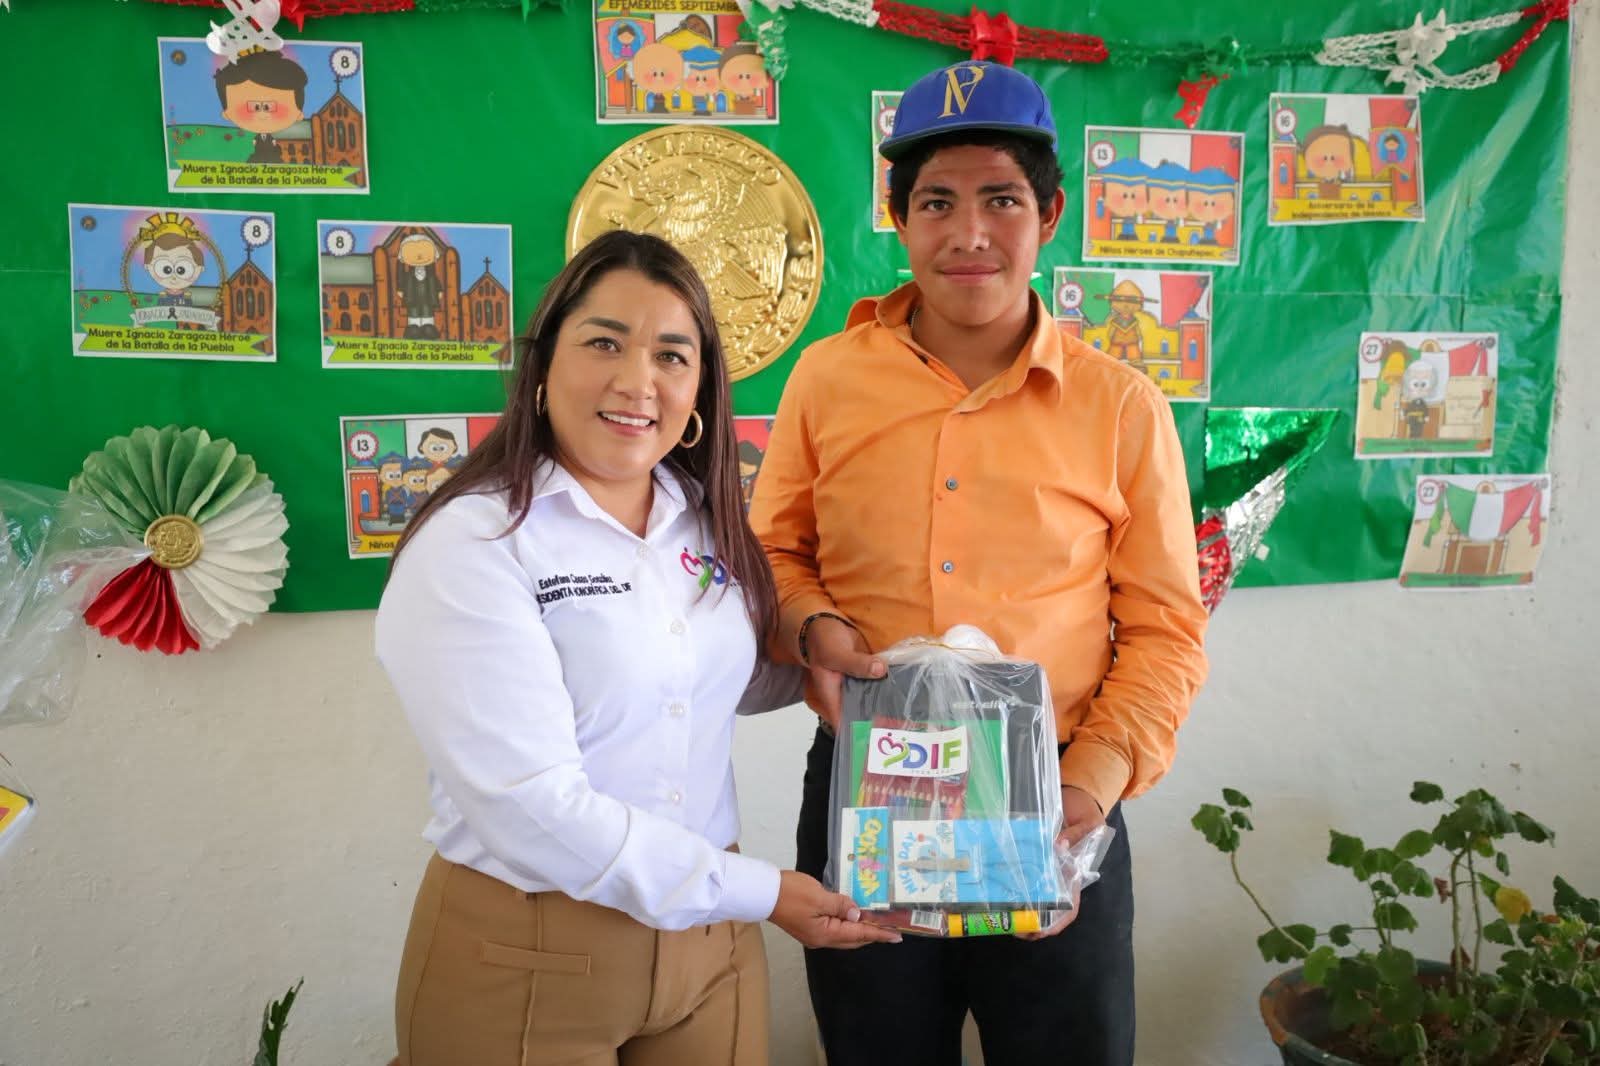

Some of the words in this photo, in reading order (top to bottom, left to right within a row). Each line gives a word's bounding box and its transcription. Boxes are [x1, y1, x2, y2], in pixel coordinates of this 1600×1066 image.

[340, 55, 350, 69] 8
[182, 164, 217, 174] Muere
[220, 164, 258, 176] Ignacio
[262, 165, 309, 176] Zaragoza
[201, 175, 213, 184] de
[216, 175, 226, 184] la
[229, 175, 264, 185] Batalla
[266, 176, 279, 185] de
[282, 176, 291, 185] la
[294, 176, 327, 185] Puebla
[252, 224, 262, 238] 8
[335, 235, 345, 249] 8
[1065, 289, 1077, 302] 16
[88, 328, 123, 339] Muere
[126, 328, 165, 340] Ignacio
[168, 330, 217, 342] Zaragoza
[105, 339, 119, 349] de
[122, 340, 131, 349] la
[134, 340, 170, 350] Batalla
[172, 341, 185, 350] de
[188, 342, 198, 351] la
[200, 342, 234, 352] Puebla
[336, 341, 369, 350] Muere
[372, 341, 409, 352] Ignacio
[411, 342, 457, 352] Zaragoza
[1366, 344, 1378, 356] 27
[352, 352, 365, 360] de
[368, 352, 377, 360] la
[380, 352, 414, 361] Batalla
[415, 353, 428, 361] de
[431, 353, 440, 361] la
[442, 353, 474, 361] Puebla
[357, 439, 369, 452] 13
[1422, 486, 1434, 498] 27
[902, 739, 962, 770] DIF
